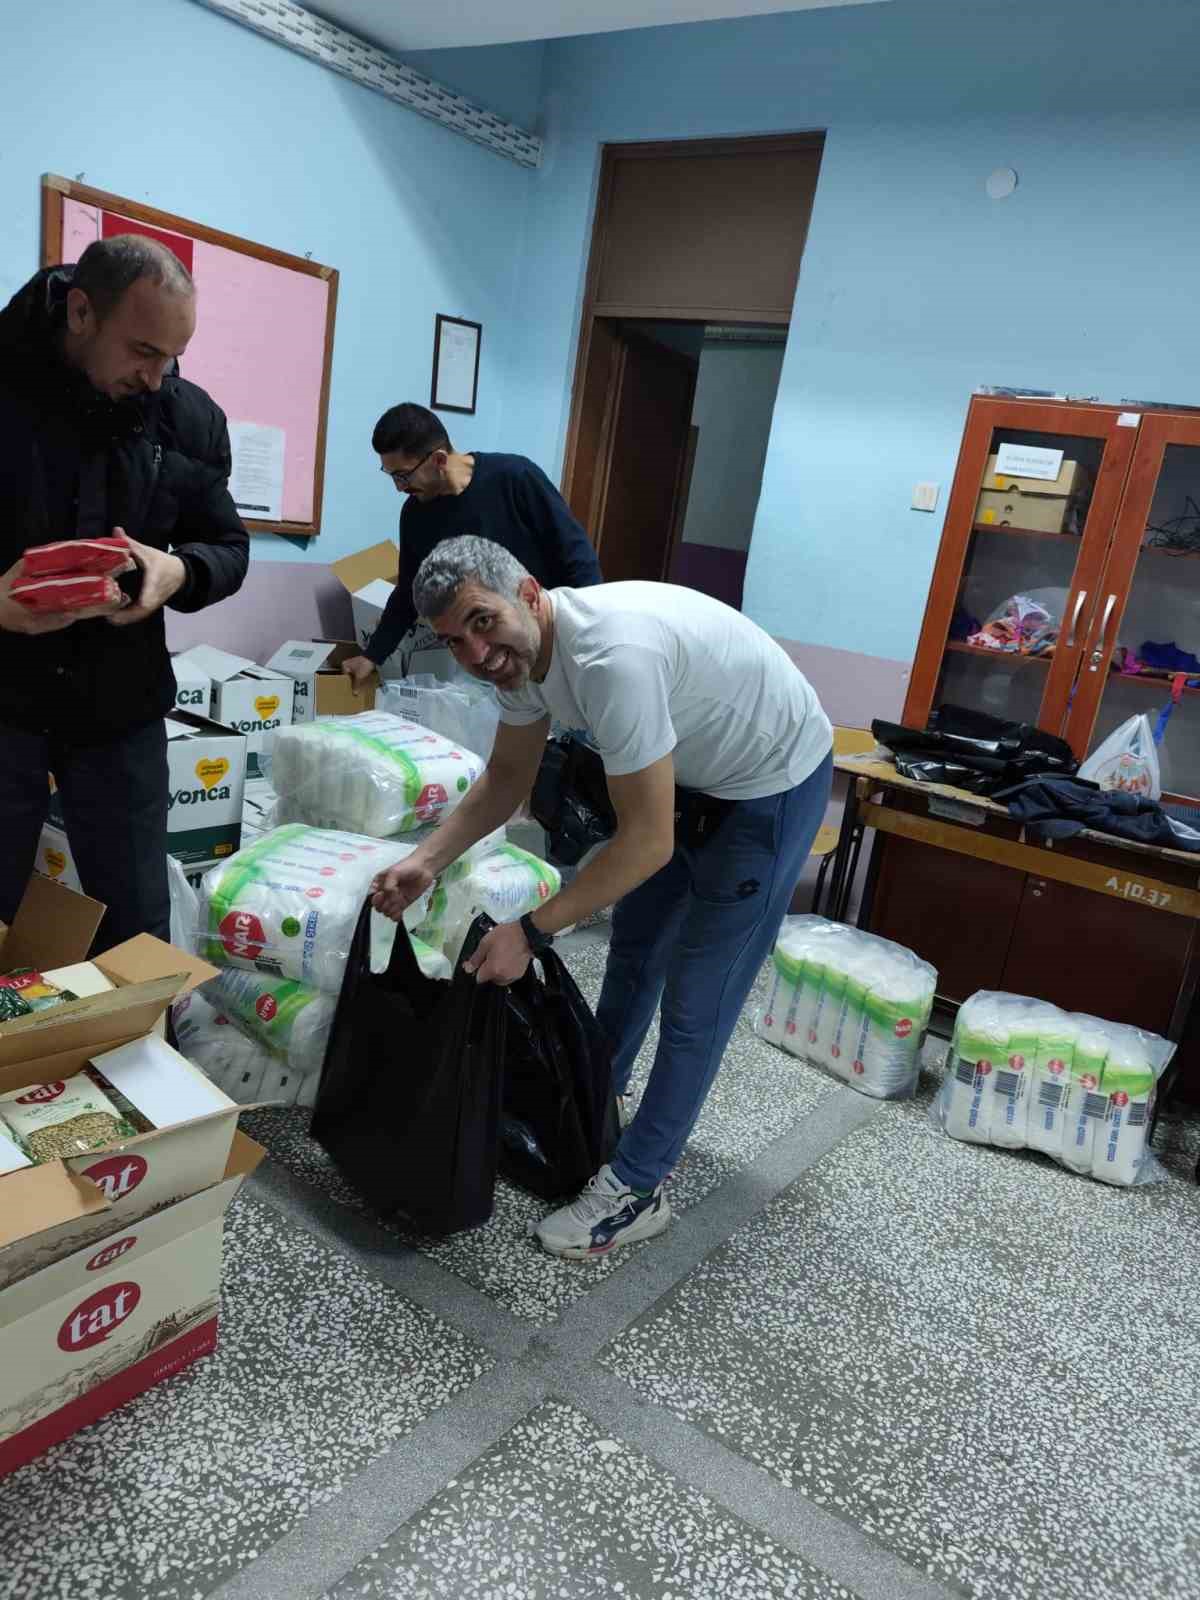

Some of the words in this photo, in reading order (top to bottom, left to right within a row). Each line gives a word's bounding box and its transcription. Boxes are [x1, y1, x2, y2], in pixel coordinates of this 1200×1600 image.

[177, 689, 203, 705] ca
[167, 786, 230, 810] yonca
[95, 1162, 138, 1199] at
[70, 1288, 132, 1344] tat
